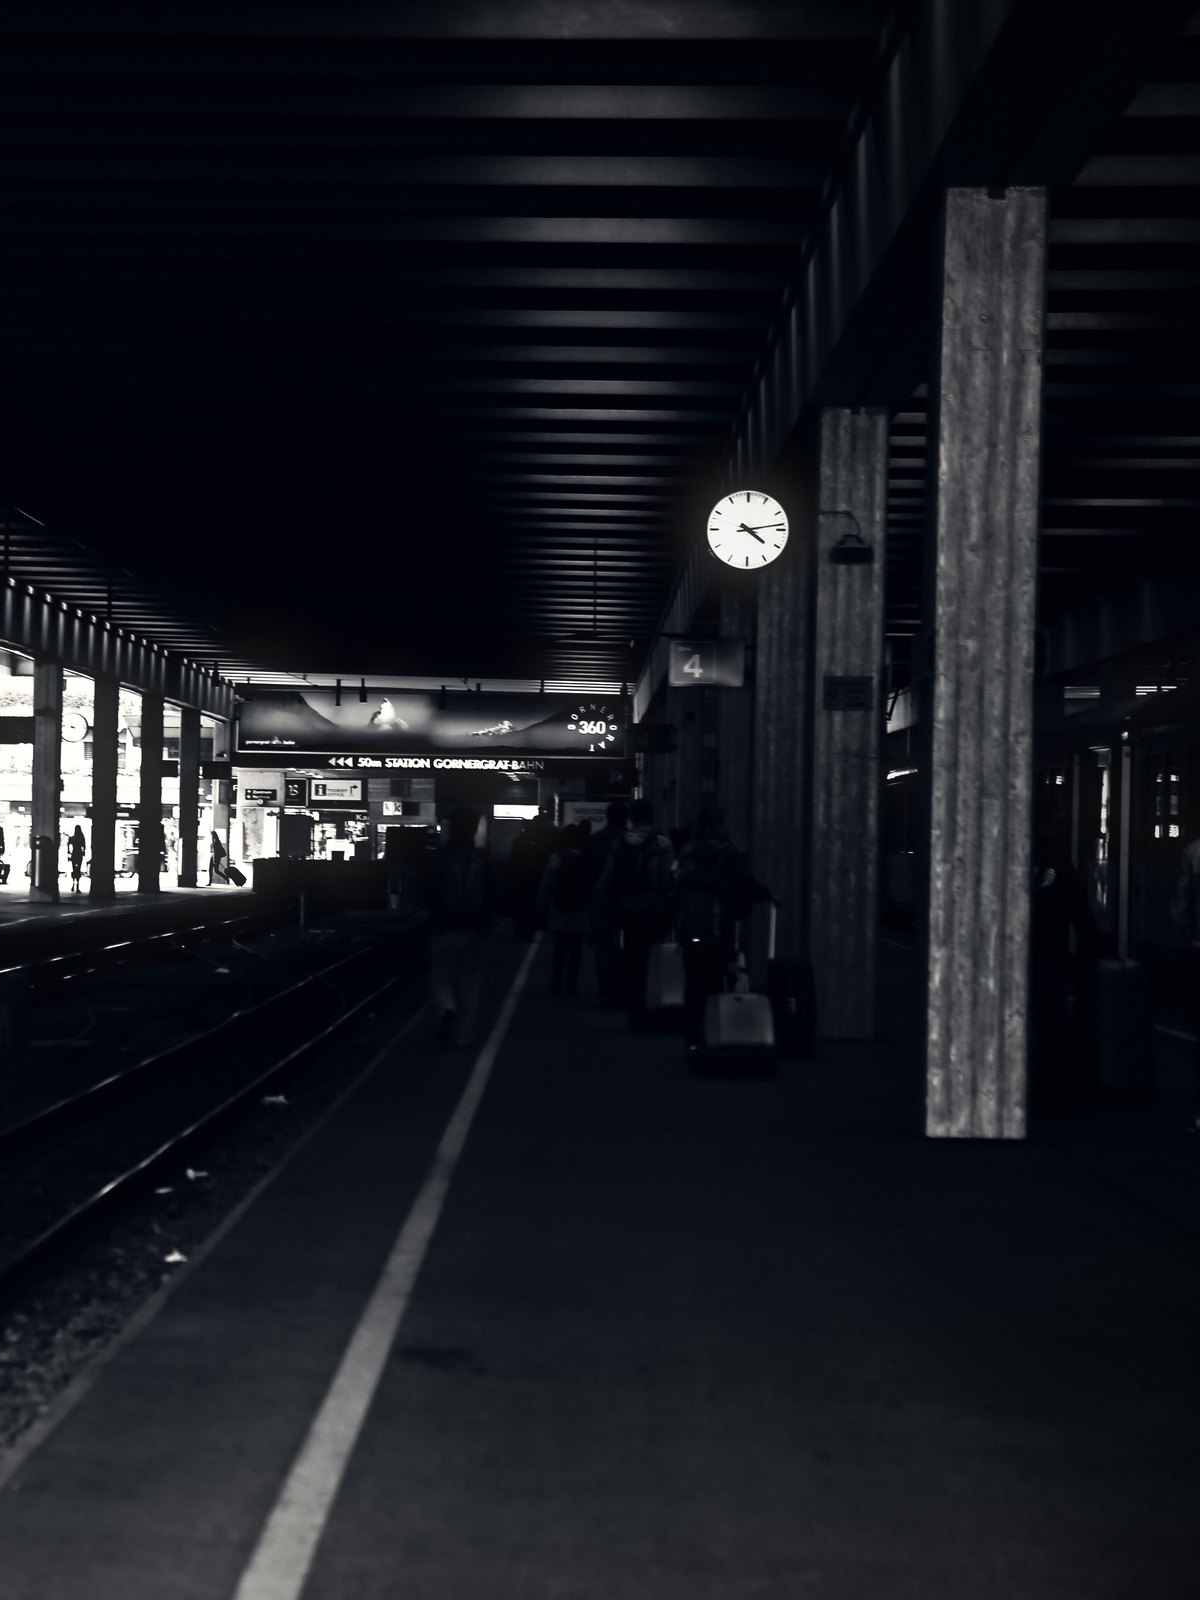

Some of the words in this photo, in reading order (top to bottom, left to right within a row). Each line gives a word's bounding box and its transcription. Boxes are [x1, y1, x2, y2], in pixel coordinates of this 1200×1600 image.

[683, 653, 704, 678] 4
[578, 720, 606, 735] 360
[357, 757, 382, 768] 50m
[384, 757, 431, 769] STATION
[433, 758, 545, 771] GORNERGRAT-BAHN
